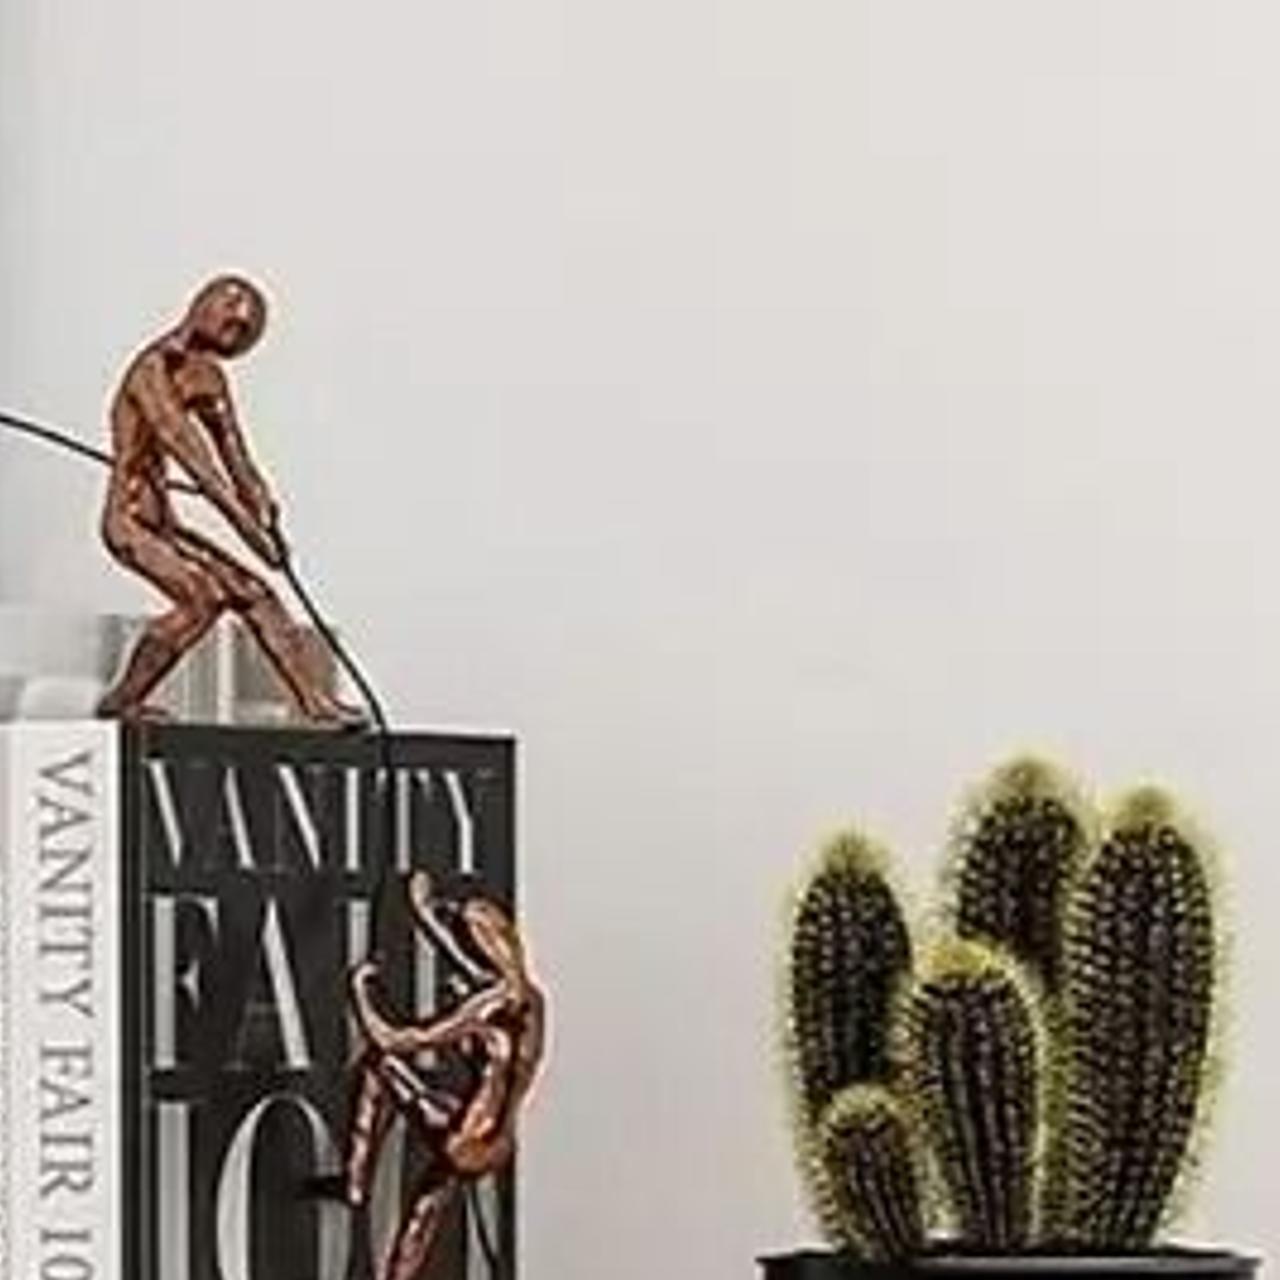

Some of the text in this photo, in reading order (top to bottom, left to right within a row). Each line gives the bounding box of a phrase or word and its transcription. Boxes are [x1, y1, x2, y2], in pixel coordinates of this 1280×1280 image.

[38, 751, 96, 1018] VANITY
[141, 757, 505, 875] VANITY
[39, 1040, 95, 1198] FAIR
